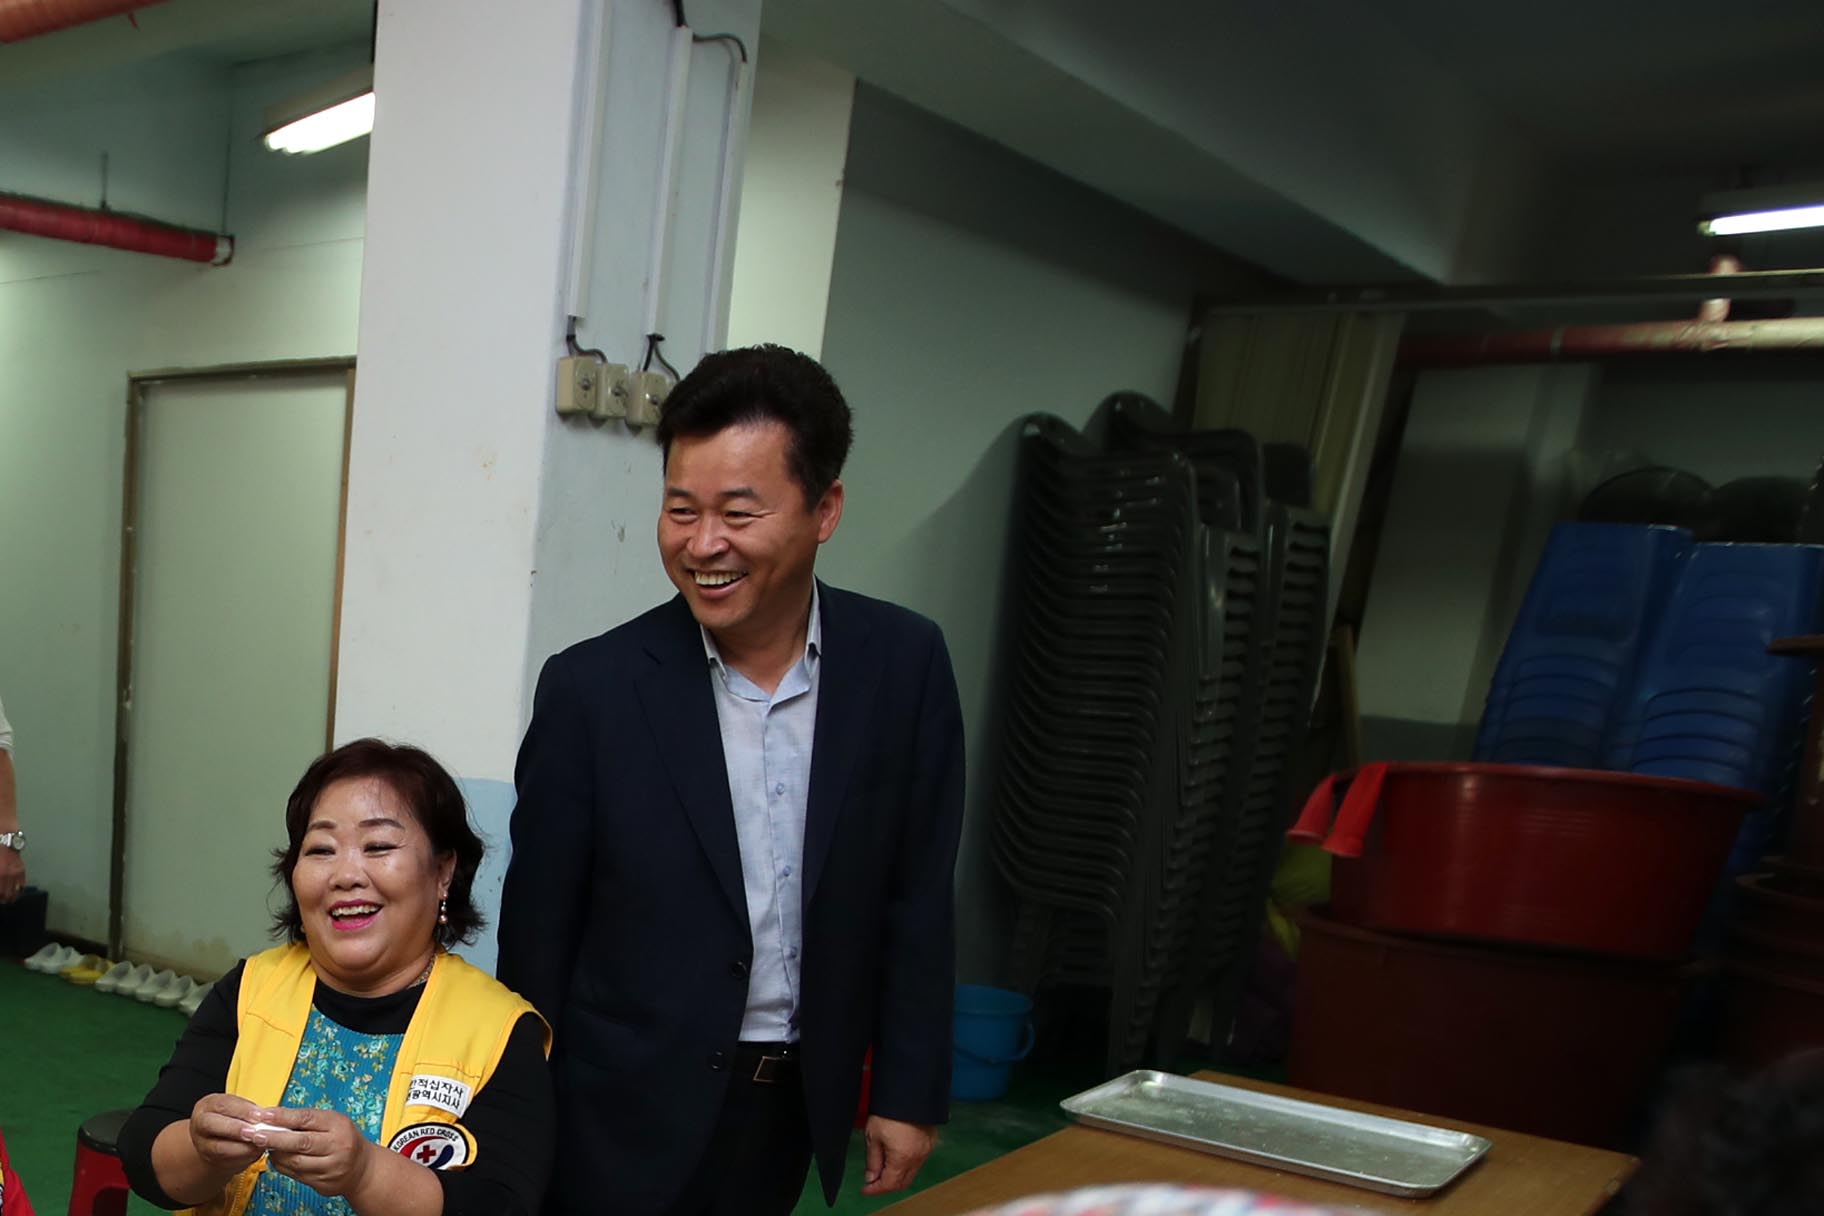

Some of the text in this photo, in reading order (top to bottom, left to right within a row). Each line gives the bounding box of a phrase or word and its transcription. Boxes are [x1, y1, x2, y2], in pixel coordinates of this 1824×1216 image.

[393, 1127, 459, 1151] KOREAN RED CROSS
